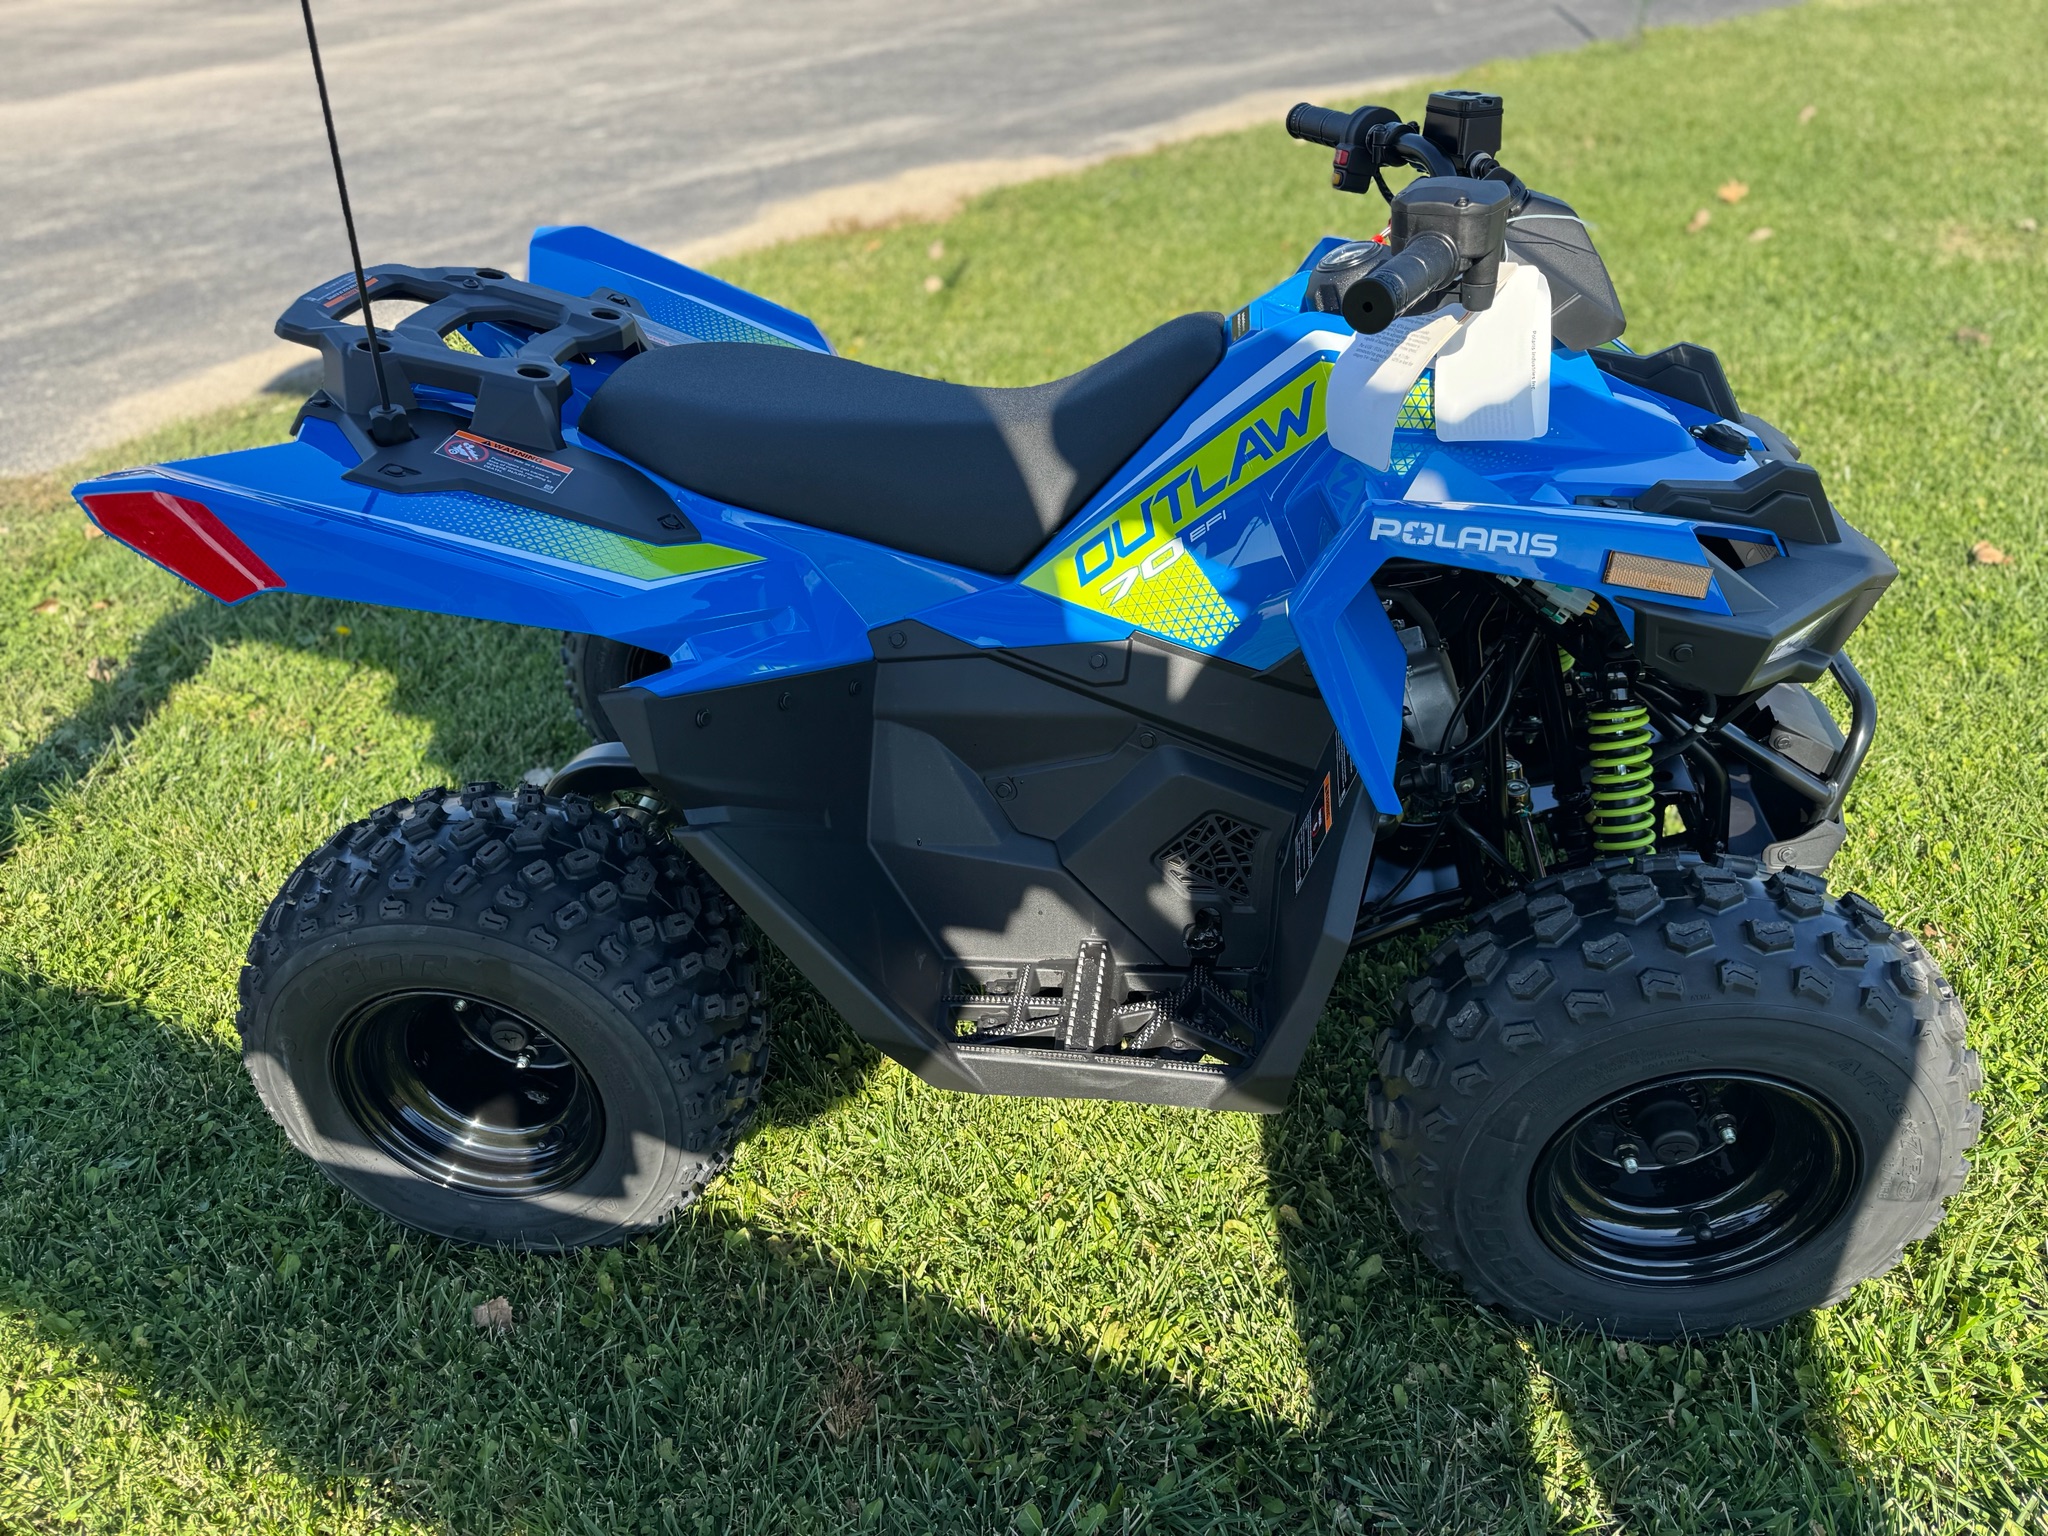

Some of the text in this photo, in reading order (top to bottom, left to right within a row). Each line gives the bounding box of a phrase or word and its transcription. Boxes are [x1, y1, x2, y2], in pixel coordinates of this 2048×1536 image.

[493, 443, 542, 463] WARNING
[1074, 380, 1318, 587] OUTLAW
[1190, 510, 1227, 543] EFI
[1370, 516, 1559, 558] POLARIS
[1100, 537, 1186, 608] 70
